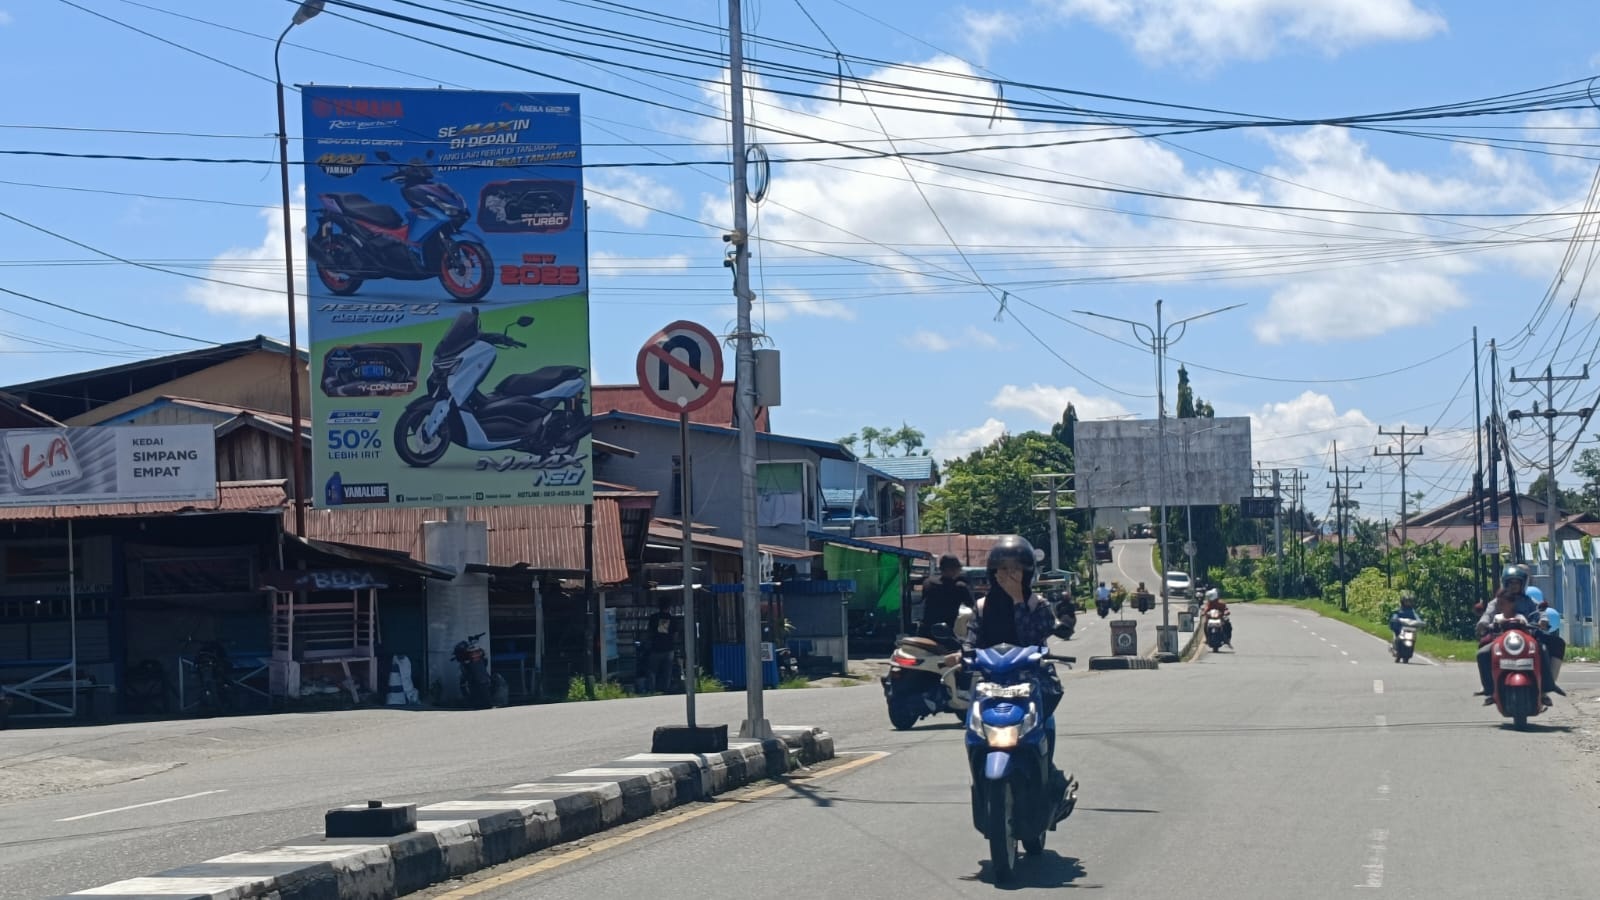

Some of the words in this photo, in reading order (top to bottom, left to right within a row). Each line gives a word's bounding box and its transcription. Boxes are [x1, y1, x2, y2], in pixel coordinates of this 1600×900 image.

[334, 98, 404, 118] YAMAHA
[468, 132, 518, 147] DEPAN
[501, 265, 579, 286] 2025
[132, 438, 164, 446] KEDAI
[328, 429, 382, 449] 50%
[133, 450, 198, 463] SIMPANG
[328, 451, 358, 460] LEBIH
[133, 466, 181, 478] EMPAT
[532, 469, 586, 487] NEO
[344, 485, 386, 498] YAMALUBE
